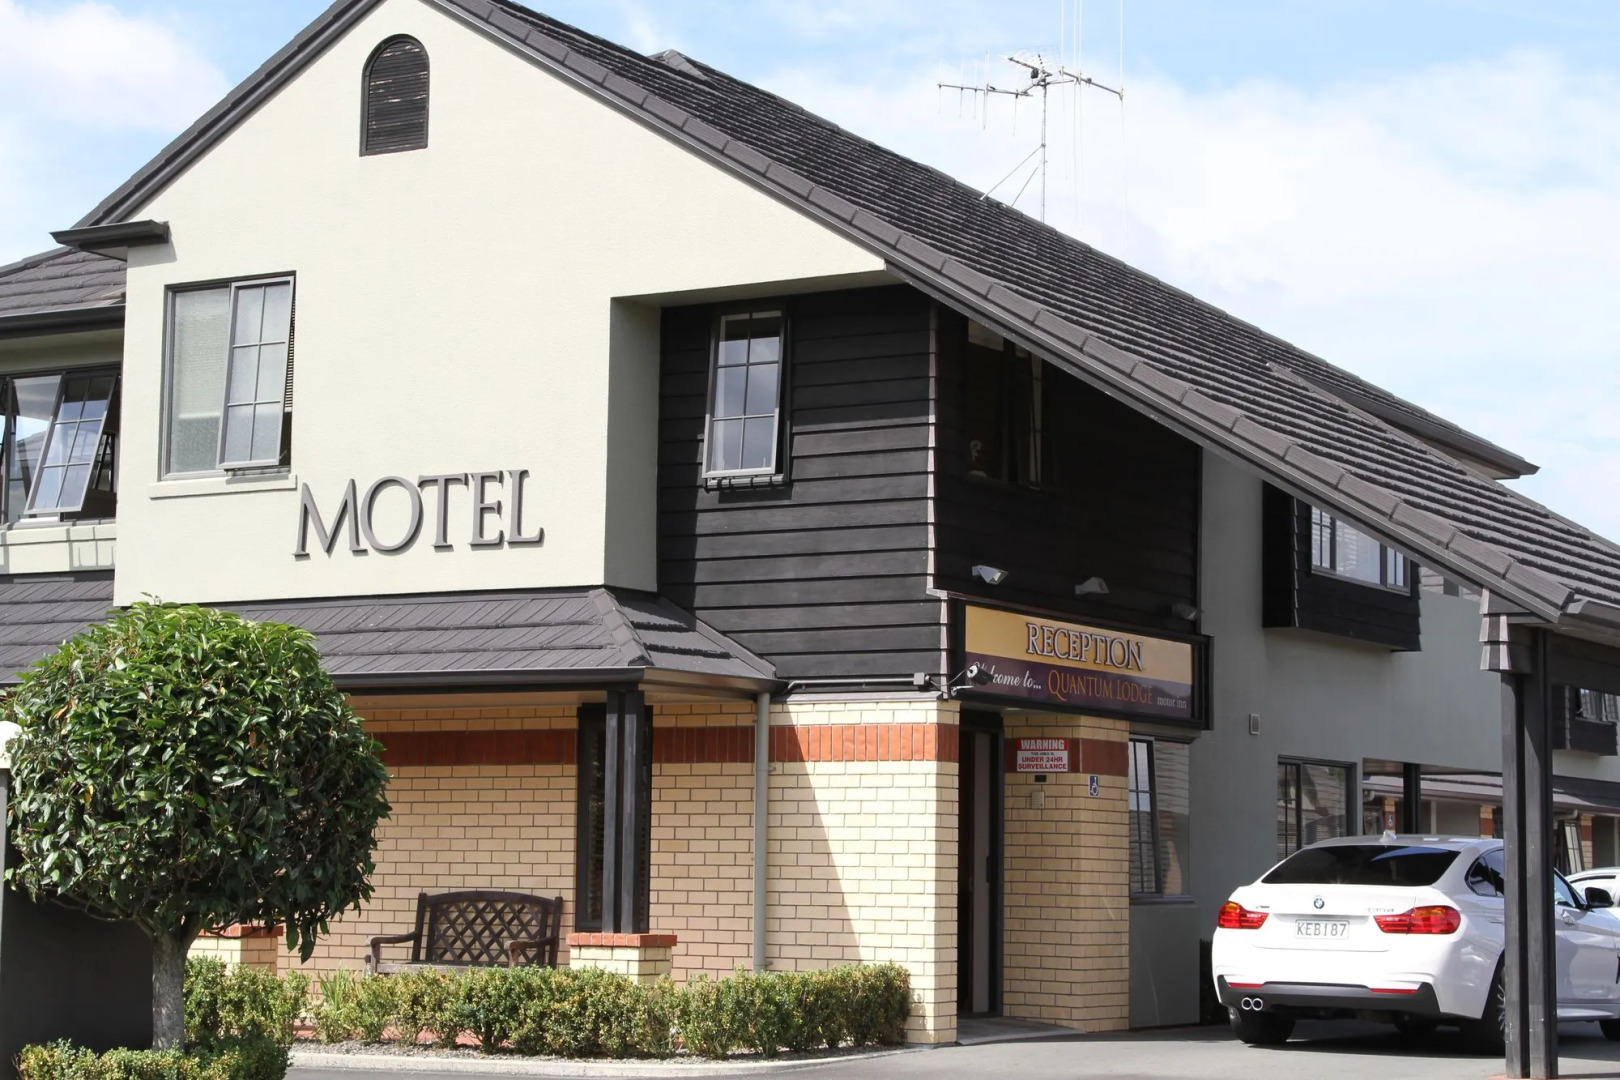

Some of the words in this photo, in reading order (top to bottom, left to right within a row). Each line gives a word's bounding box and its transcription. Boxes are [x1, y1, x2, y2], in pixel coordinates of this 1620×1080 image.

[292, 469, 545, 561] MOTEL
[1026, 622, 1144, 671] RECEPTION
[973, 661, 1020, 686] lcome
[1048, 669, 1113, 702] QUANTUM
[1117, 679, 1153, 704] LODGE
[1157, 696, 1176, 709] motor
[1176, 695, 1187, 709] inn
[1021, 739, 1065, 750] WARNING
[1297, 922, 1347, 936] KEB187
